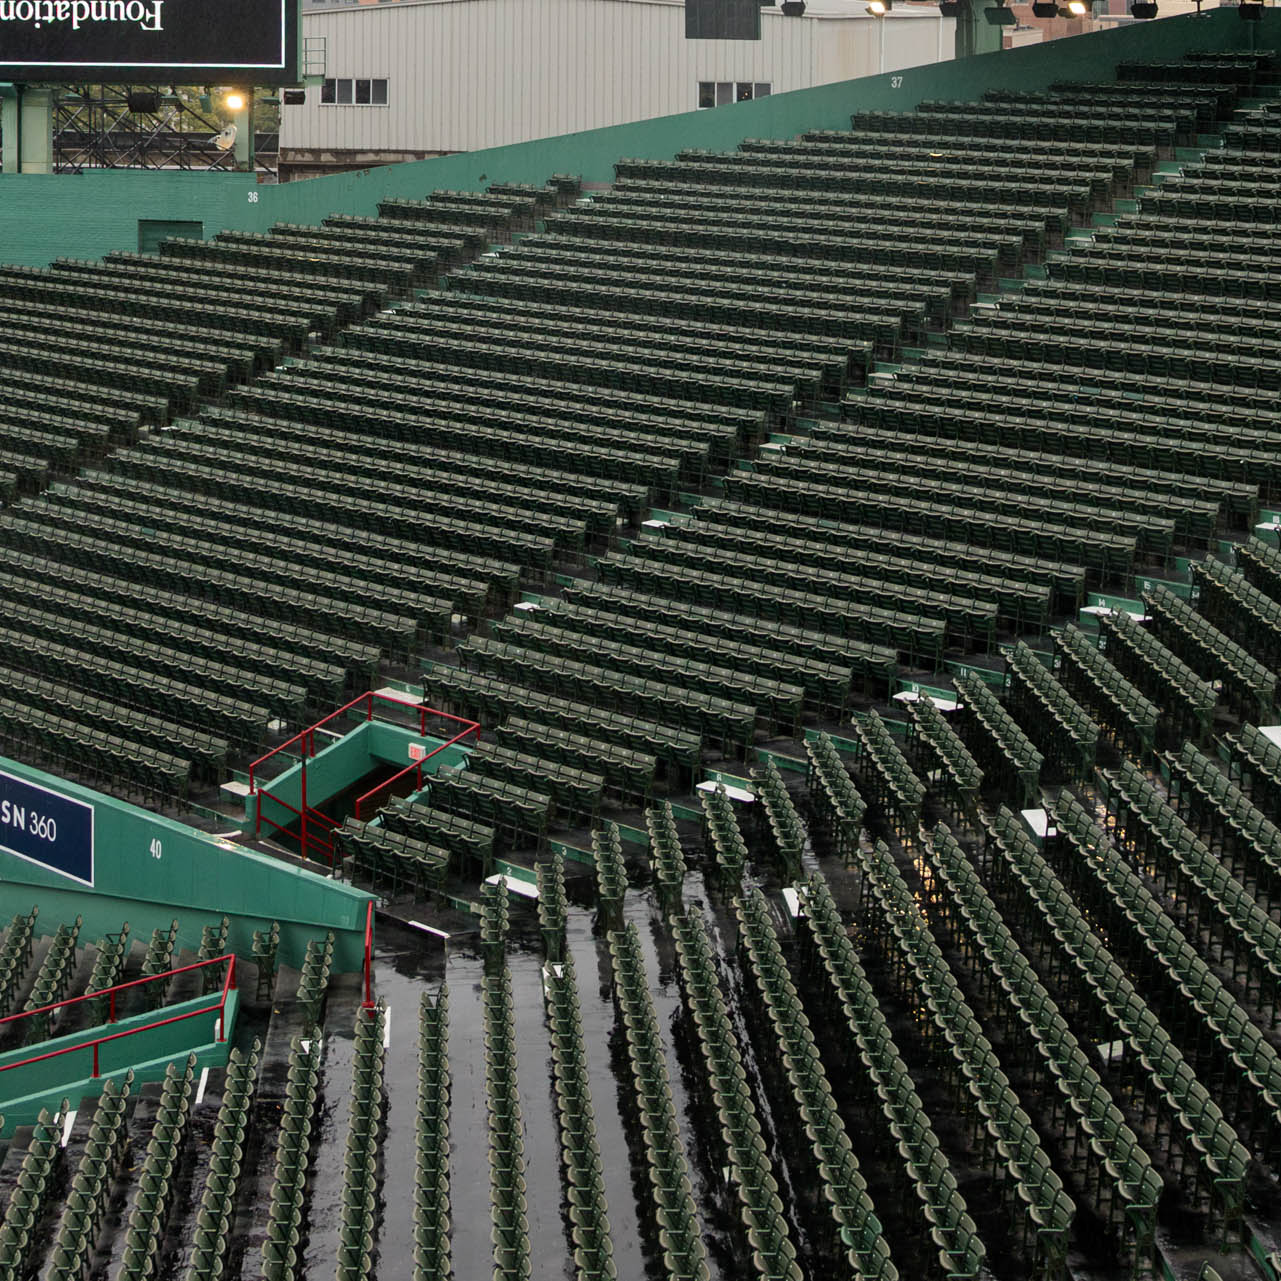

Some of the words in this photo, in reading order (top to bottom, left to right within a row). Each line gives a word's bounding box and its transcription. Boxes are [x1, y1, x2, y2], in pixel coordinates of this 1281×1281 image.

[890, 76, 903, 89] 37
[247, 192, 258, 203] 36
[29, 810, 58, 843] 360
[150, 838, 162, 861] 40
